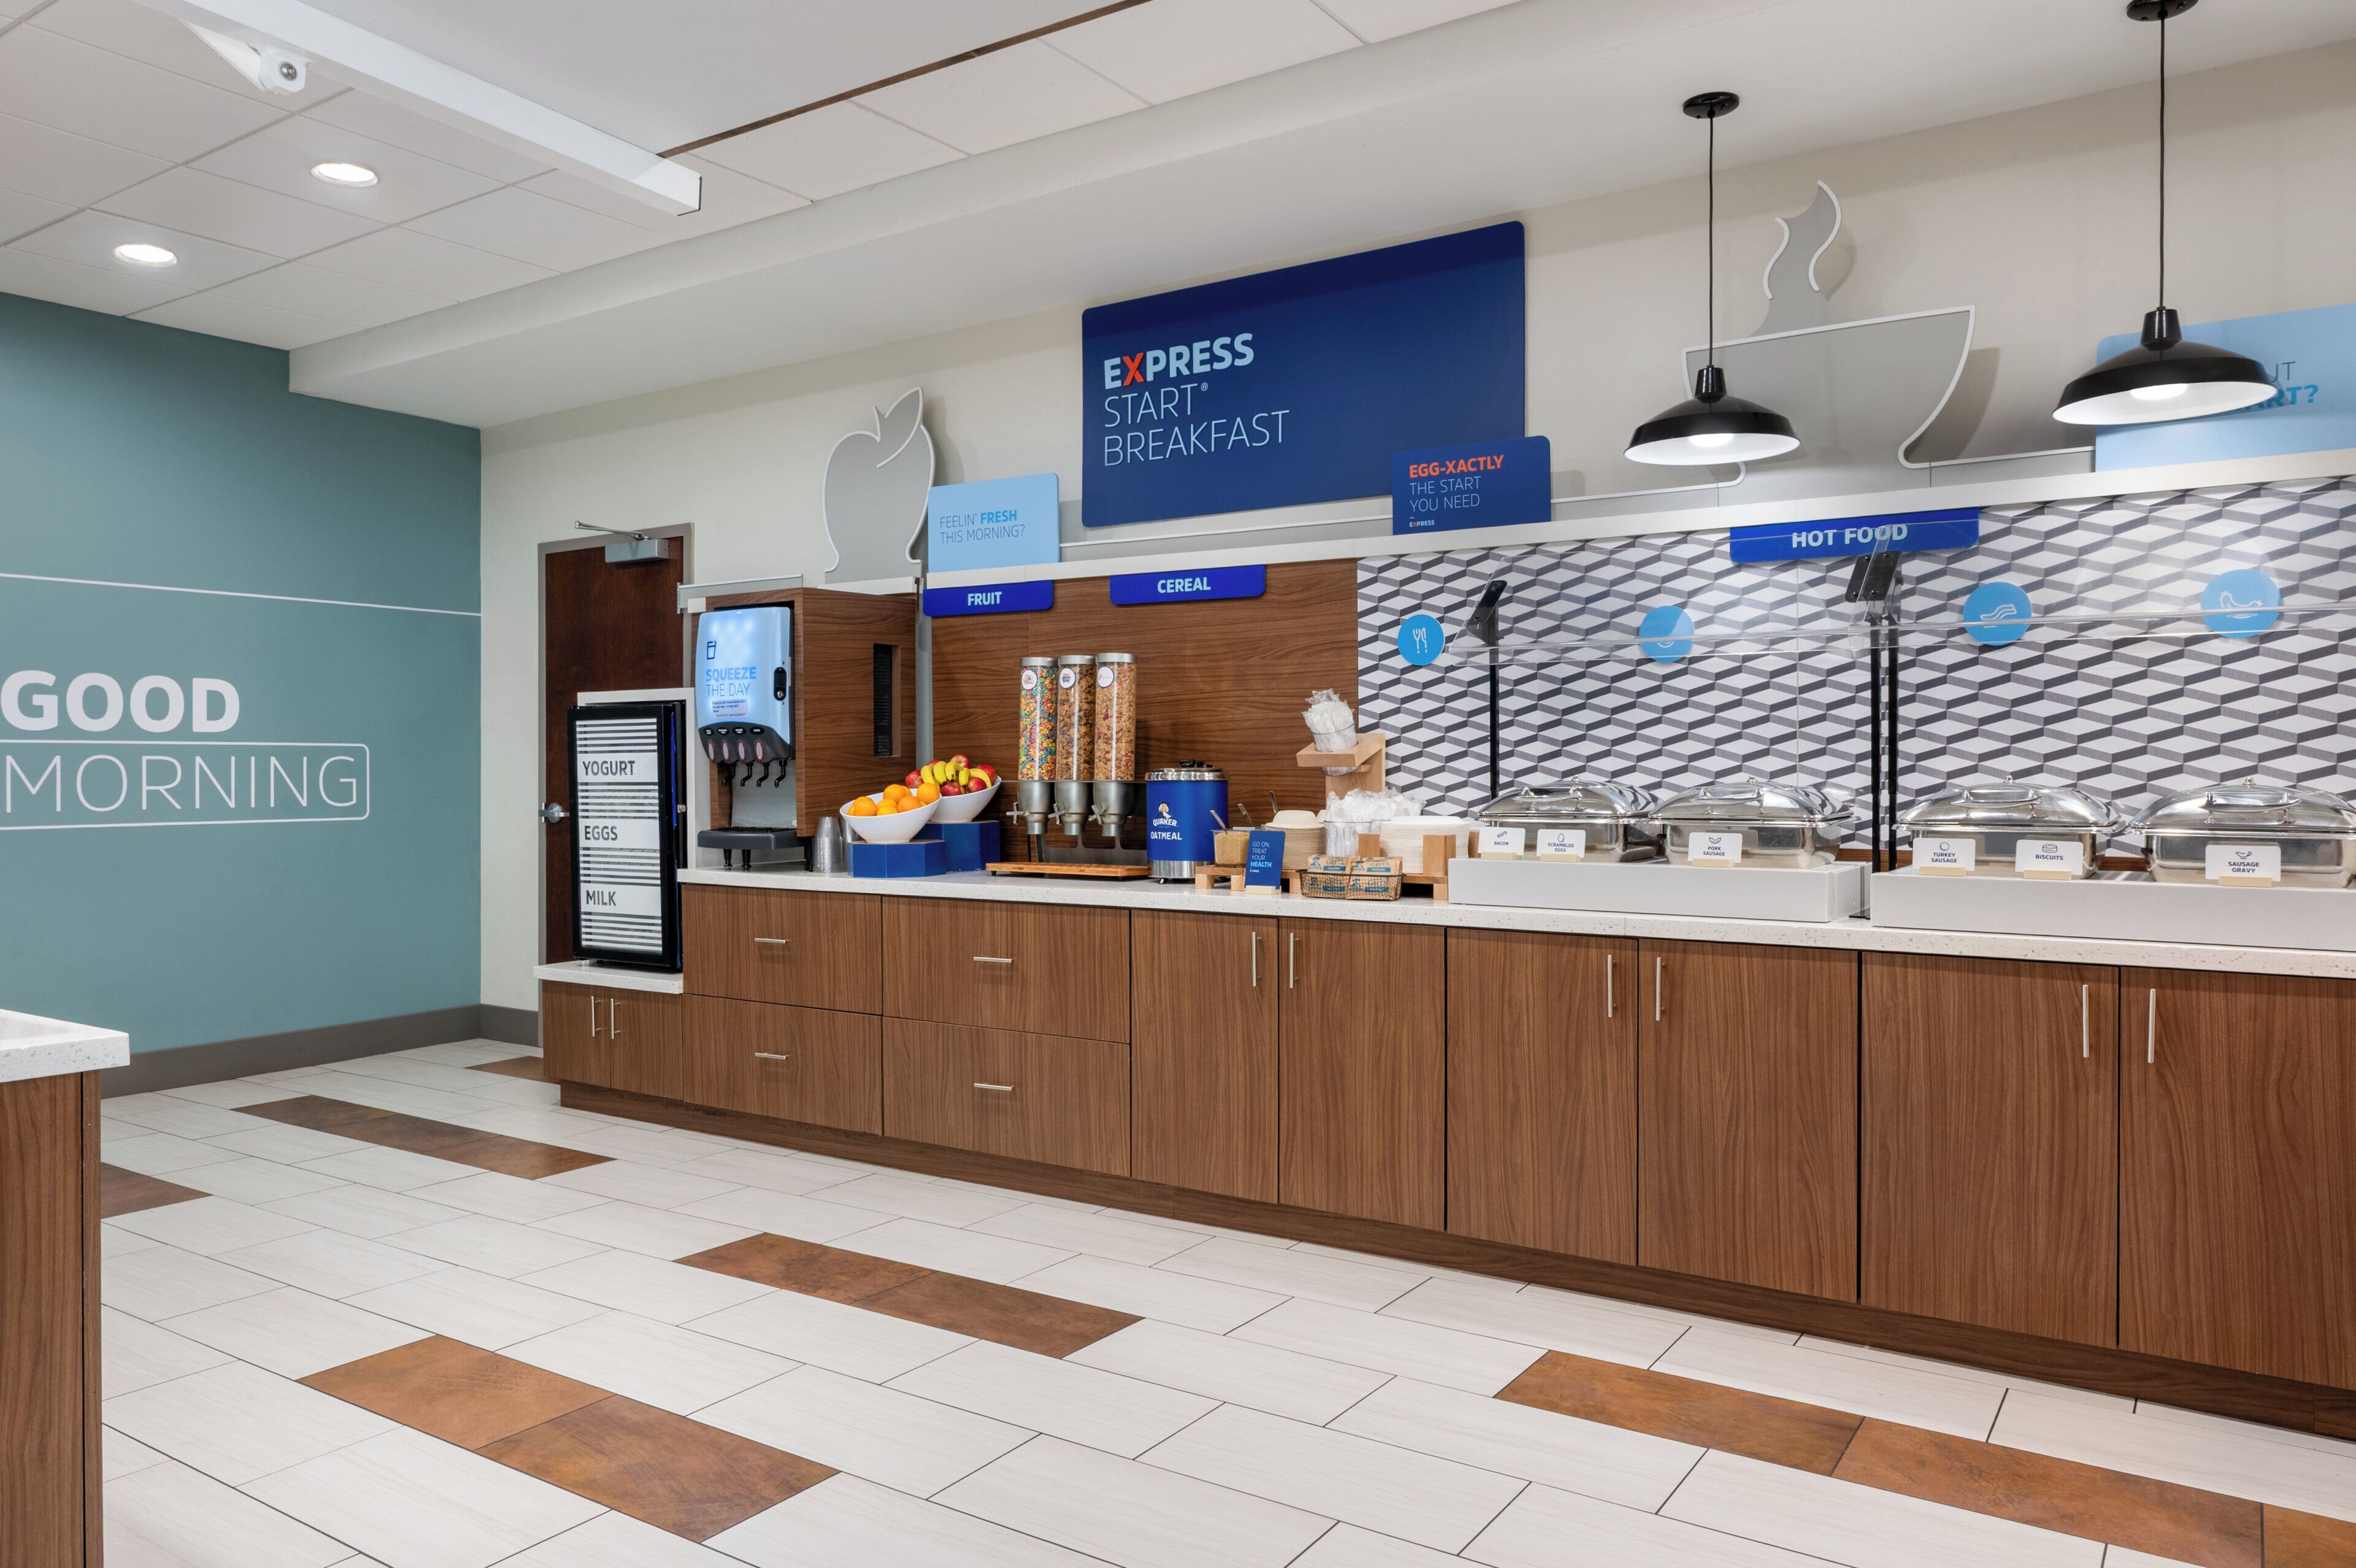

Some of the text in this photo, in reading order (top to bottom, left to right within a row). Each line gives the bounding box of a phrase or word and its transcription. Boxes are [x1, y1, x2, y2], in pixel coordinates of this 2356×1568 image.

[1104, 333, 1255, 390] EXPRESS
[1104, 410, 1290, 466] BREAKFAST
[1409, 455, 1504, 478] EGG-XACTLY
[1409, 476, 1481, 496] THE START
[1409, 494, 1480, 512] YOU NEED
[980, 509, 1017, 524] FRESH
[940, 524, 1025, 544] THIS MORNING?
[1792, 523, 1908, 548] HOT FOOD
[1157, 577, 1211, 593] CEREAL
[968, 591, 1002, 606] FRUIT
[706, 667, 756, 682] SQUEEZE
[706, 682, 751, 697] THE DAY
[1, 670, 240, 732] GOOD
[582, 760, 635, 776] YOGURT
[6, 755, 357, 813] MORNING
[1152, 818, 1177, 826] QUAKER
[584, 826, 618, 841] EGGS
[1150, 831, 1182, 840] OATMEAL
[586, 890, 617, 906] MILK
